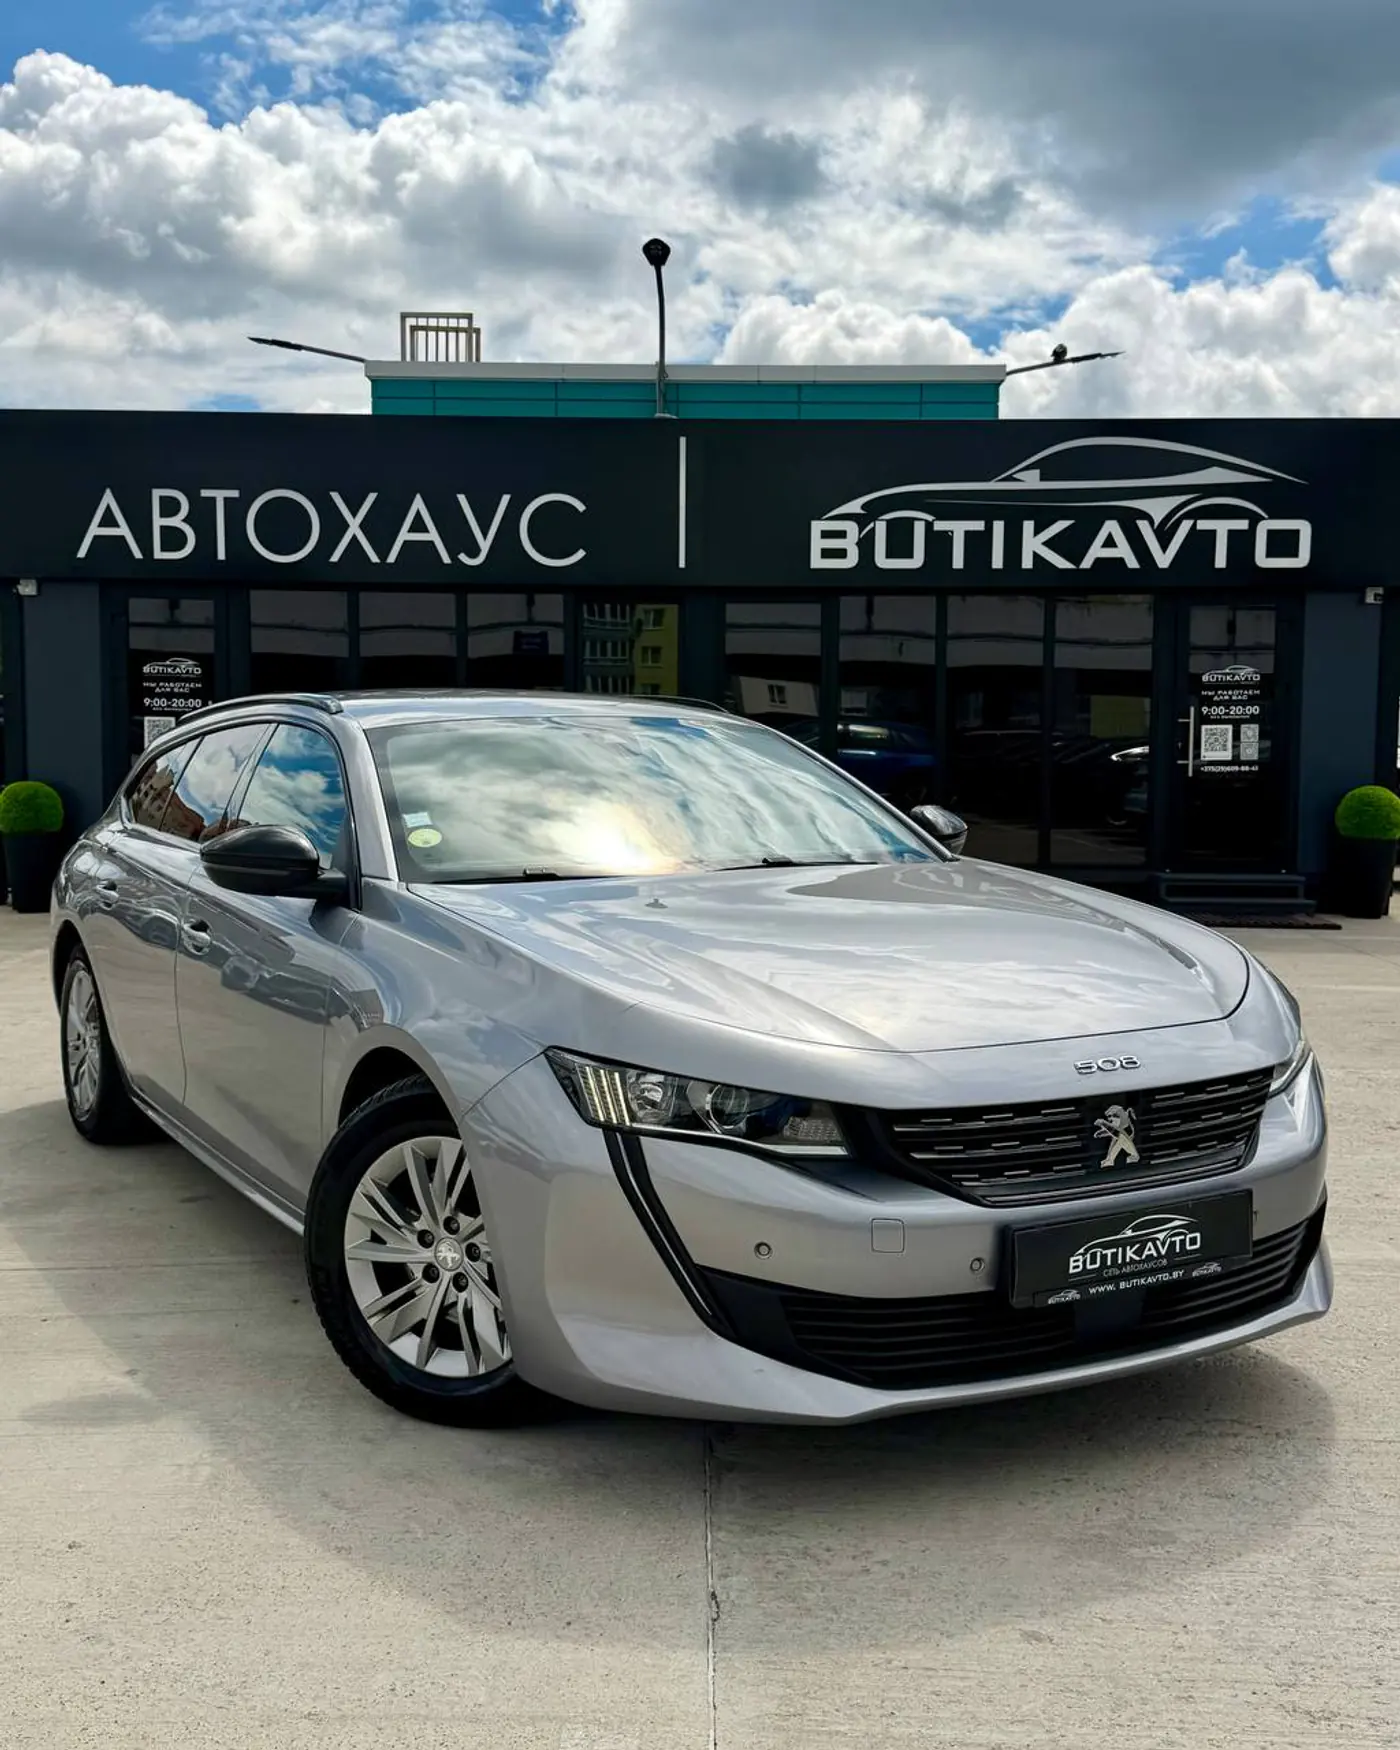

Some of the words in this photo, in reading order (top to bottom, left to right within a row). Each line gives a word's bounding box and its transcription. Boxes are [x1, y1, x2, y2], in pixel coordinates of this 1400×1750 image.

[76, 487, 588, 568] АВТОХАУС
[810, 519, 1313, 569] BUTIKAVTO
[143, 666, 202, 674] BUTIKAVTO
[1202, 674, 1261, 682] BUTIKAVTO
[144, 698, 202, 707] 9:00-20:00
[1202, 705, 1260, 715] 9:00-20:00
[1074, 1055, 1141, 1075] 508
[1069, 1232, 1201, 1274] BUTIKAVTO
[1119, 1270, 1185, 1289] BUTIKAVTO.BY
